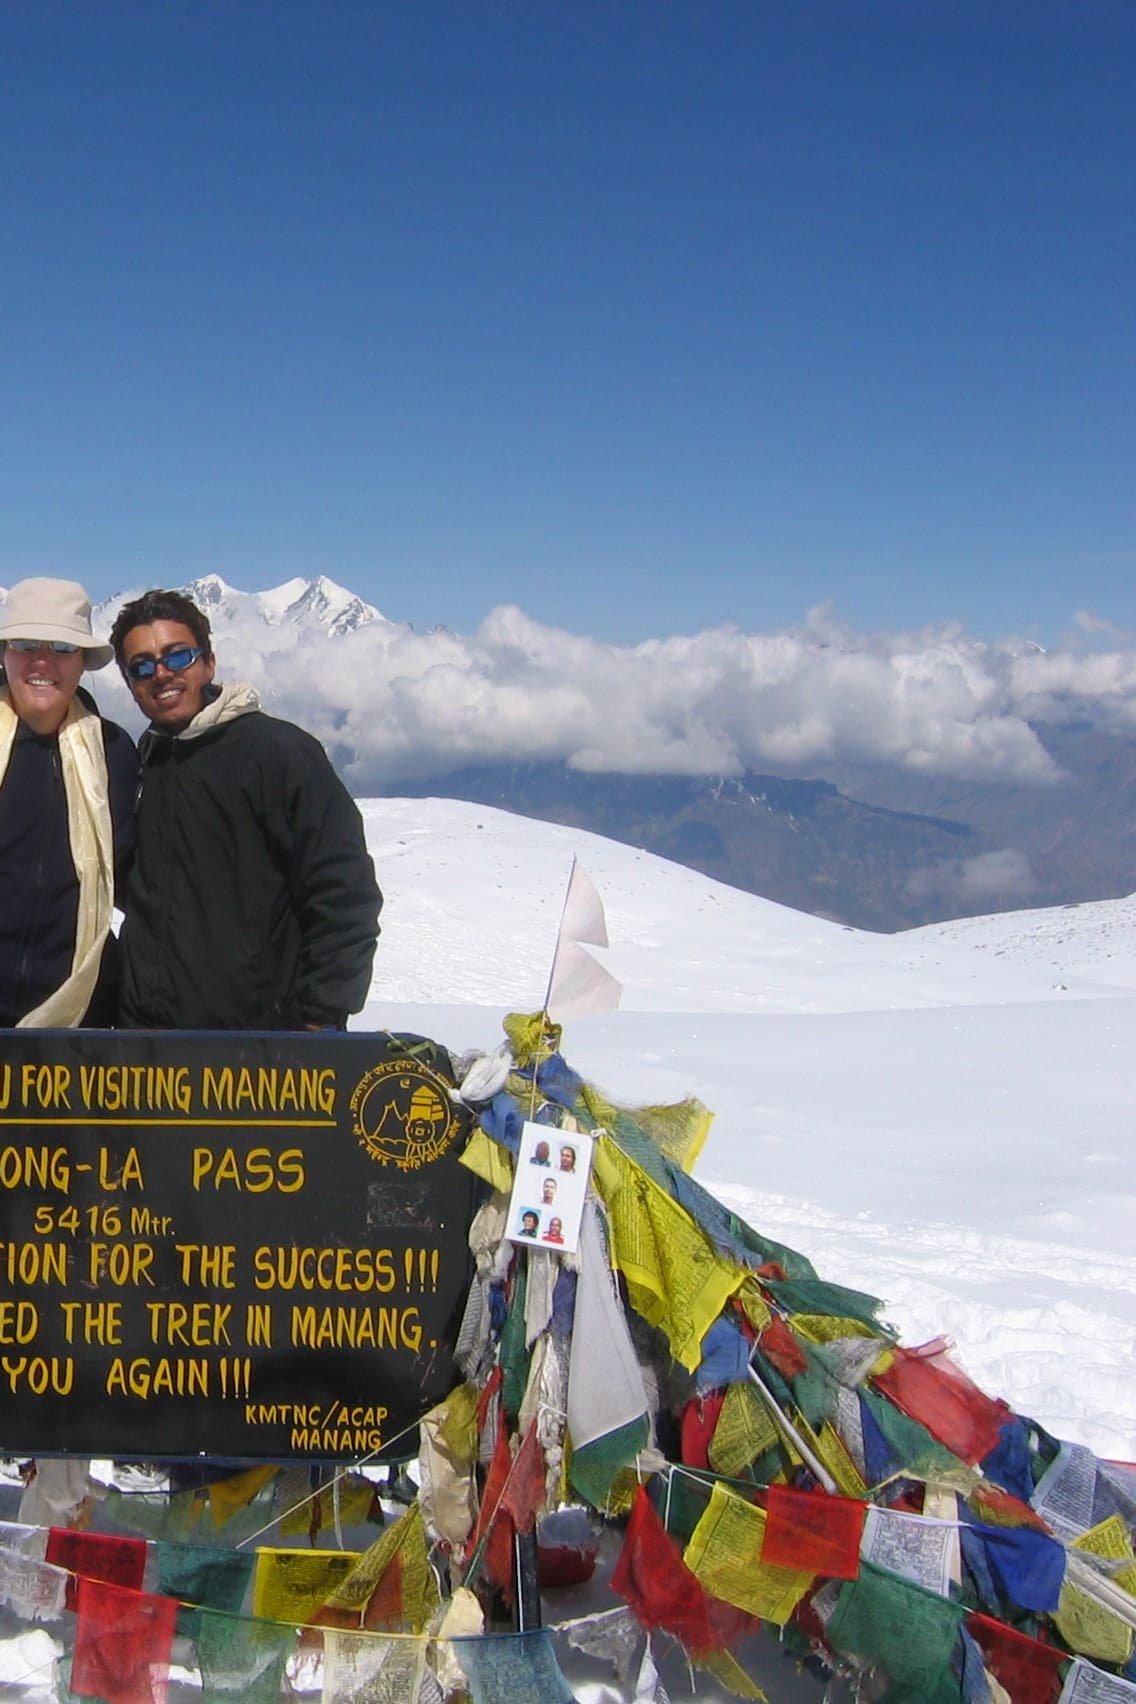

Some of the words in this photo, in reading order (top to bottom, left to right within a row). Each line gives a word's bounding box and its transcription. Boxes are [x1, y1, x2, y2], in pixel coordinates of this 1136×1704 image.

[21, 1064, 71, 1109] FOR
[79, 1065, 192, 1115] VISITING
[202, 1066, 336, 1117] MANANG
[192, 1147, 305, 1193] PASS
[34, 1205, 122, 1237] 5416
[130, 1207, 176, 1237] Mtr.
[90, 1241, 154, 1287] FOR
[175, 1244, 237, 1289] THE
[59, 1302, 123, 1345] THE
[145, 1302, 232, 1347] TREK
[246, 1304, 272, 1348] IN
[1, 1356, 74, 1396] YOU
[245, 1401, 388, 1430] KMTNC/ACAP
[291, 1428, 381, 1452] MANANG
